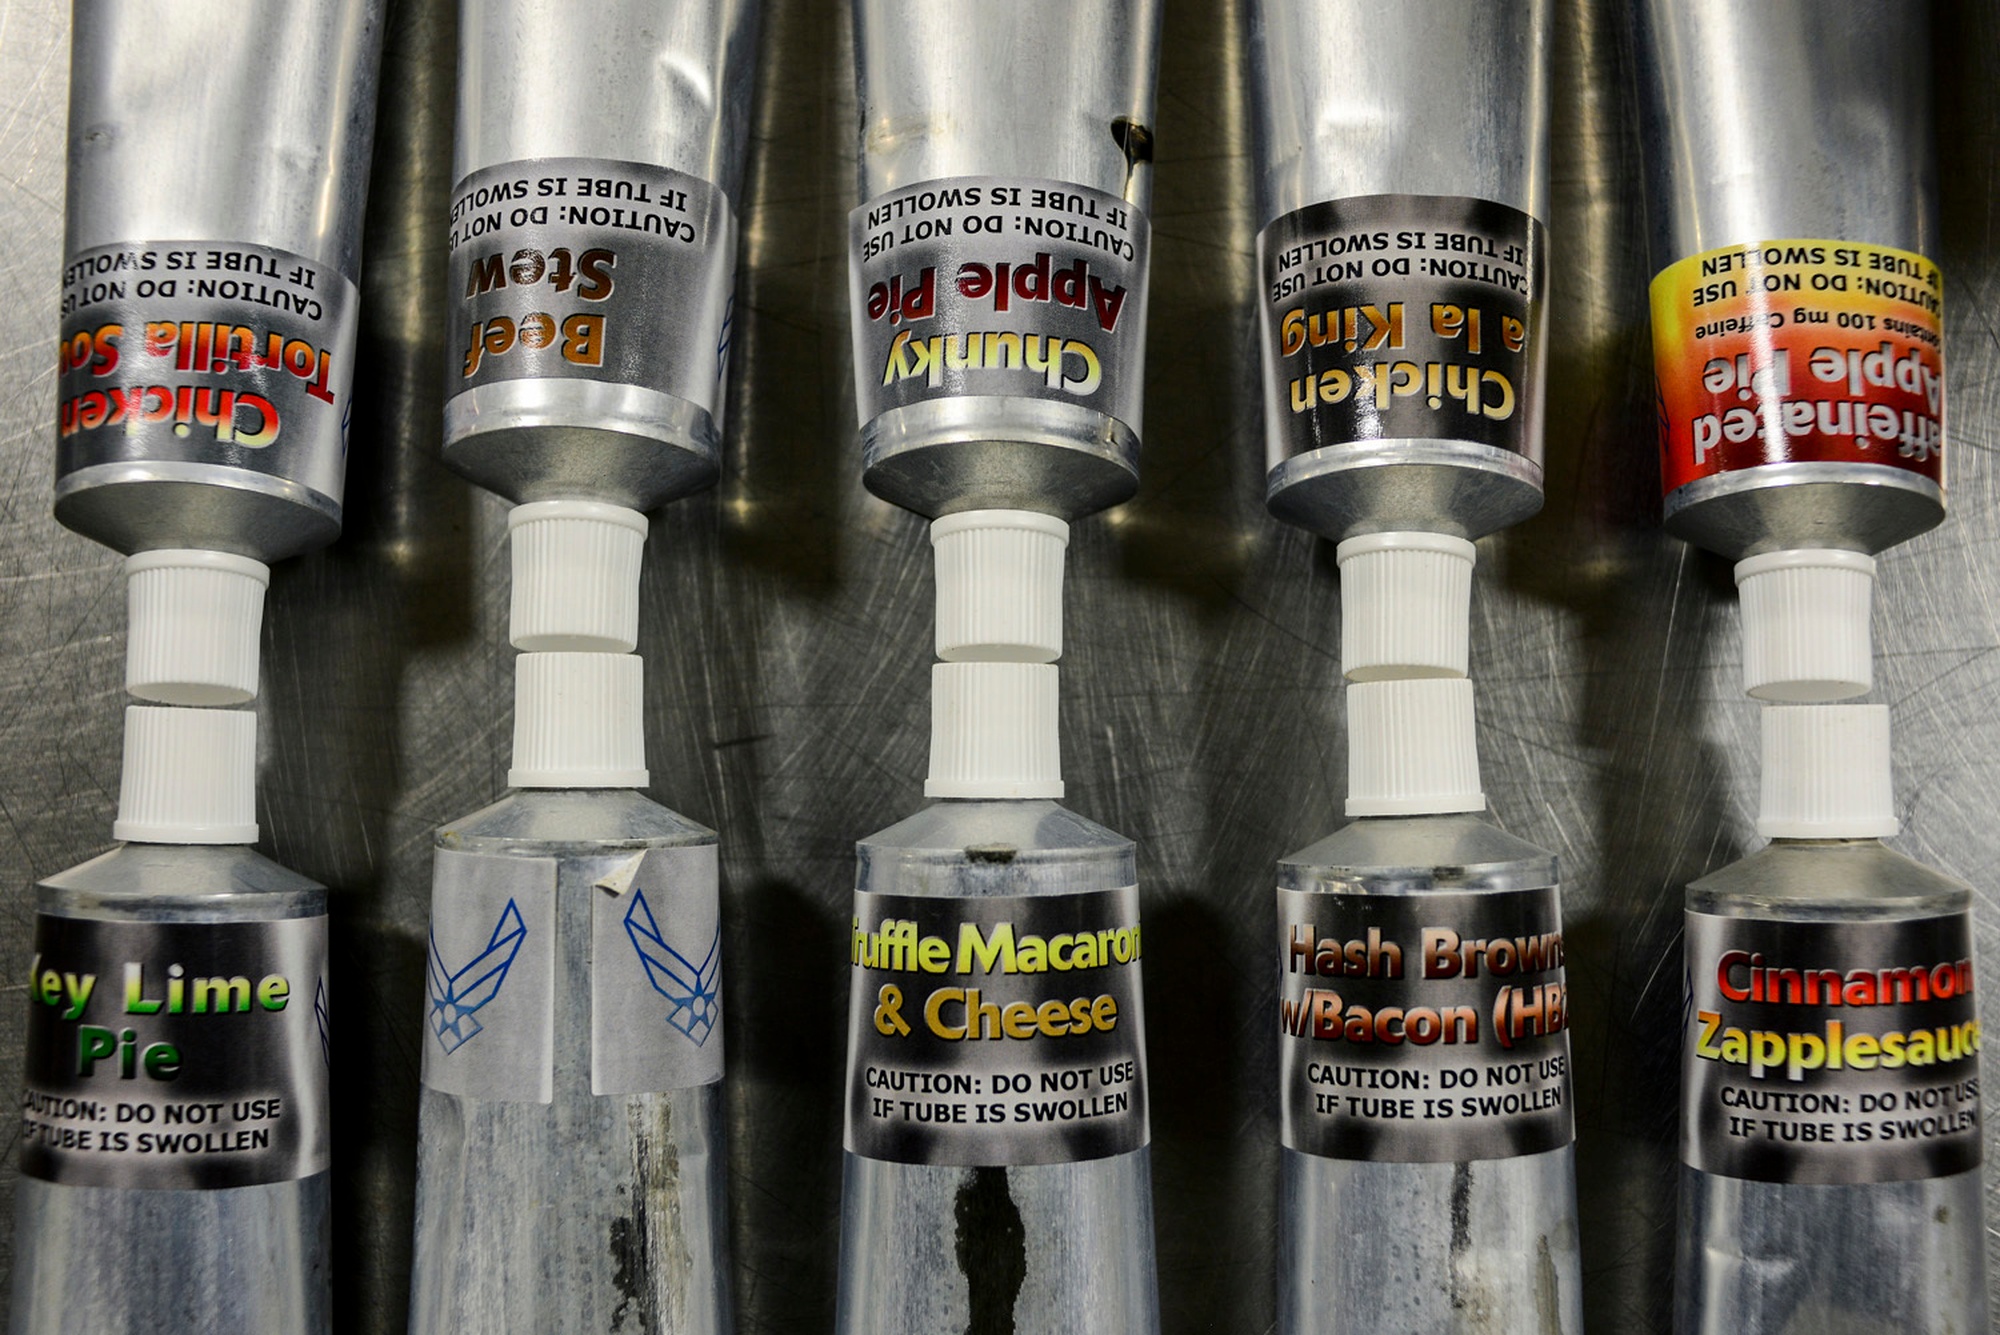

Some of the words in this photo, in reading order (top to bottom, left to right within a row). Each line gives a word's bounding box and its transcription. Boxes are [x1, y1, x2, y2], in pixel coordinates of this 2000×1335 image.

[538, 177, 568, 196] IS
[578, 177, 651, 203] TUBE
[660, 190, 687, 212] IF
[991, 187, 1021, 207] IS
[511, 206, 548, 226] DO
[868, 187, 981, 230] SWOLLEN
[1032, 189, 1099, 218] TUBE
[461, 212, 501, 244] NOT
[559, 206, 695, 244] CAUTION:
[900, 218, 951, 244] NOT
[963, 215, 1001, 234] DO
[1107, 209, 1128, 230] IF
[863, 230, 893, 262] USE
[1015, 216, 1134, 262] CAUTION:
[1279, 232, 1389, 273] SWOLLEN
[1397, 232, 1426, 249] IS
[1434, 232, 1499, 259] TUBE
[167, 251, 197, 270] IS
[208, 251, 281, 279] TUBE
[1372, 257, 1410, 277] DO
[1503, 245, 1524, 267] IF
[1702, 247, 1826, 277] SWOLLEN
[1835, 248, 1861, 268] IS
[1870, 252, 1922, 280] TUBE
[290, 266, 315, 290] IF
[465, 247, 617, 302] Stew
[1273, 273, 1305, 302] USE
[1313, 260, 1363, 286] NOT
[1420, 258, 1529, 296] CAUTION:
[1812, 274, 1847, 291] DO
[80, 280, 126, 306] NOT
[137, 279, 176, 299] DO
[187, 280, 322, 321] CAUTION:
[868, 266, 937, 325] Pie
[955, 252, 1128, 333] Apple
[1692, 280, 1738, 308] USE
[1281, 302, 1405, 357] King
[1431, 303, 1481, 354] la
[1793, 307, 1829, 326] mg
[1838, 312, 1876, 330] 100
[463, 311, 607, 378] Beef
[1502, 315, 1525, 353] a
[146, 321, 335, 405] Tortilla
[882, 329, 1102, 396] Chunky
[1702, 349, 1791, 401] Pie
[1289, 360, 1515, 421] Chicken
[1810, 341, 1941, 415] Apple
[62, 386, 280, 449] Chicken
[1290, 923, 1403, 979] Hash
[123, 961, 291, 1015] Lime
[874, 983, 911, 1038] &
[924, 986, 1118, 1040] Cheese
[1280, 987, 1479, 1046] w/Bacon
[76, 1024, 183, 1081] Pie
[866, 1066, 982, 1094] CAUTION:
[992, 1074, 1032, 1094] DO
[1040, 1069, 1093, 1093] NOT
[1100, 1061, 1133, 1086] USE
[1307, 1063, 1430, 1089] CAUTION:
[1440, 1069, 1478, 1089] DO
[1486, 1062, 1534, 1086] NOT
[1538, 1056, 1565, 1080] USE
[116, 1103, 155, 1124] DO
[165, 1103, 224, 1124] NOT
[232, 1098, 281, 1121] USE
[872, 1097, 894, 1118] IF
[900, 1101, 967, 1123] TUBE
[975, 1103, 1006, 1123] IS
[1014, 1092, 1128, 1122] SWOLLEN
[1316, 1093, 1339, 1114] IF
[1345, 1096, 1414, 1119] TUBE
[1423, 1099, 1453, 1119] IS
[1461, 1086, 1561, 1117] SWOLLEN
[1721, 1087, 1850, 1114] CAUTION:
[1859, 1092, 1896, 1114] DO
[1905, 1087, 1950, 1110] NOT
[38, 1123, 91, 1150] TUBE
[99, 1131, 129, 1152] IS
[136, 1129, 269, 1153] SWOLLEN
[1729, 1116, 1756, 1137] IF
[1762, 1121, 1833, 1143] TUBE
[1843, 1122, 1872, 1143] IS
